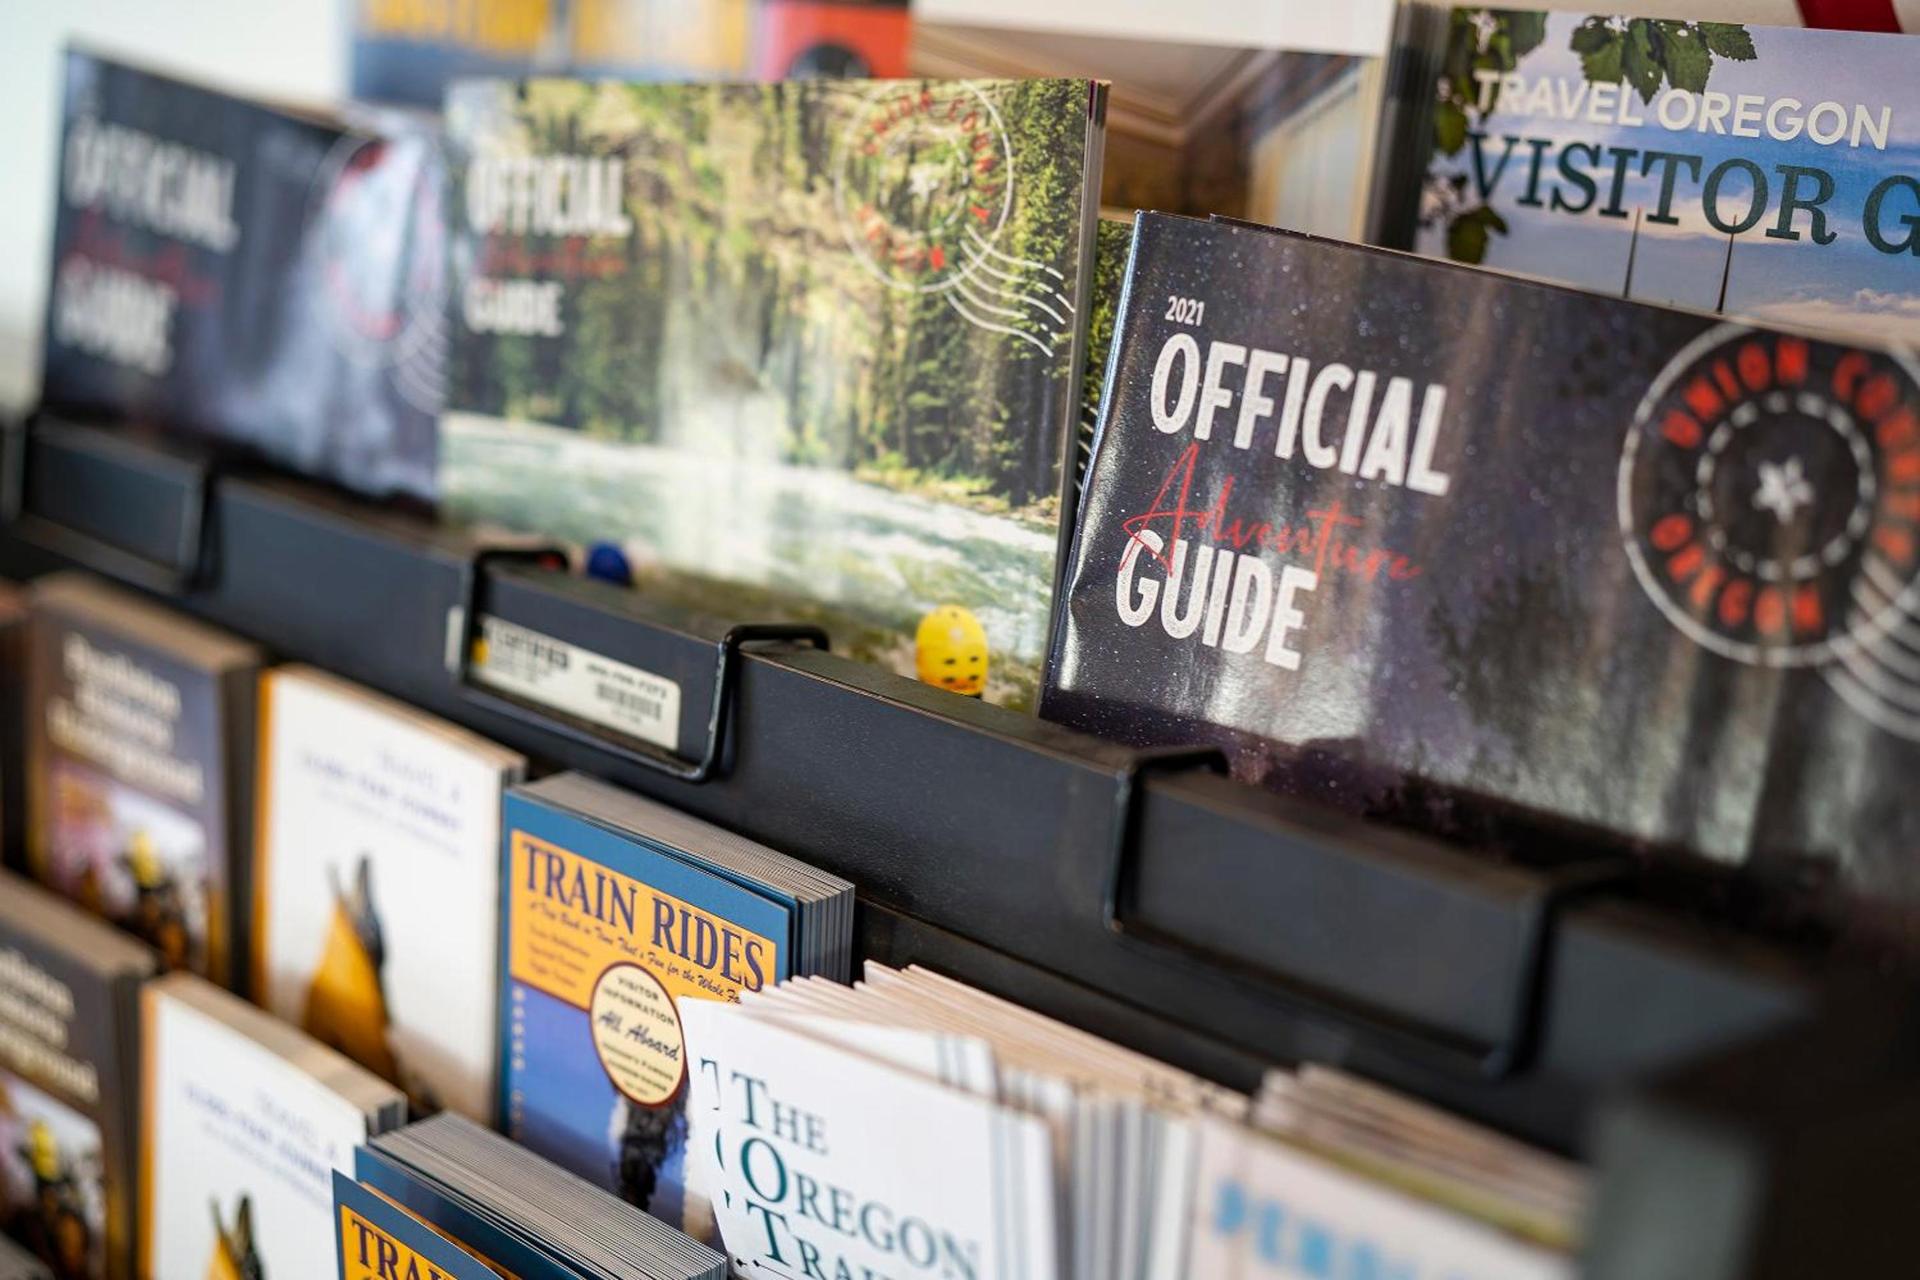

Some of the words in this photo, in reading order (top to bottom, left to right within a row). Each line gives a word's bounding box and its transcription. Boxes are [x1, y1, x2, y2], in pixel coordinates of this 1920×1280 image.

[1473, 68, 1643, 127] TRAVEL
[1657, 88, 1892, 151] OREGON
[1469, 132, 1838, 246] VISITOR
[1165, 295, 1205, 327] 2021
[1150, 332, 1452, 496] OFFICIAL
[1118, 440, 1423, 583] Adventure
[1115, 528, 1319, 672] GUIDE
[523, 841, 638, 936] TRAIN
[651, 895, 765, 994] RIDES
[599, 1010, 624, 1033] All
[617, 977, 660, 1002] VISITOR
[667, 962, 680, 976] for
[682, 968, 695, 983] the
[697, 974, 723, 997] Whole
[731, 1069, 830, 1156] THE
[351, 1217, 449, 1280] TRA
[740, 1136, 980, 1280] OREGON
[746, 1198, 893, 1280] TRA
